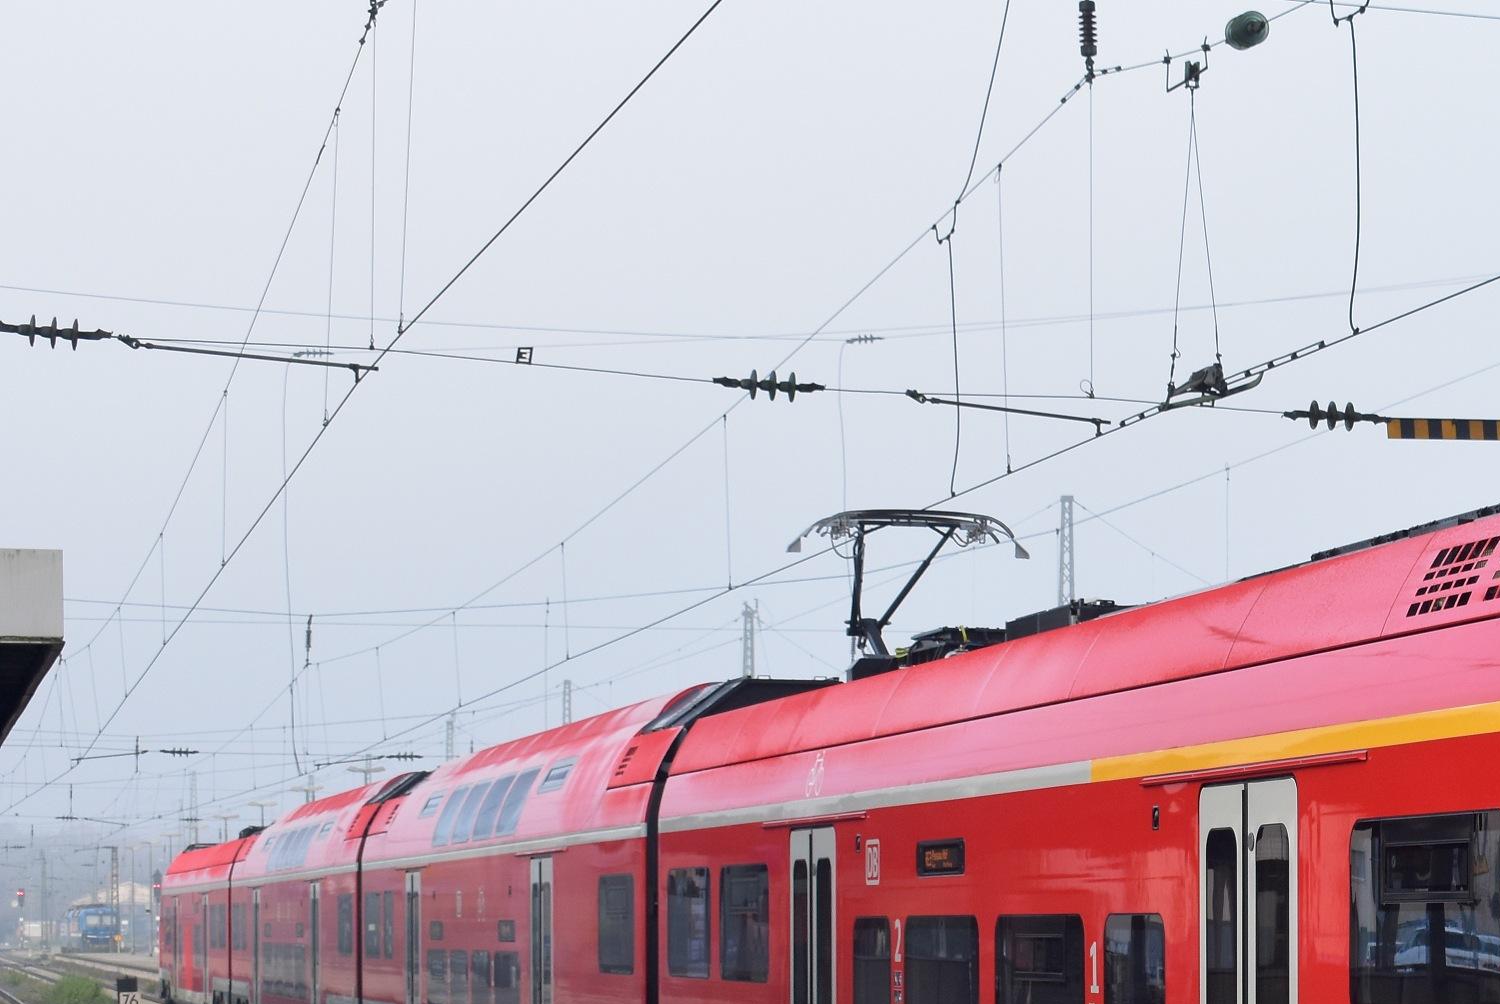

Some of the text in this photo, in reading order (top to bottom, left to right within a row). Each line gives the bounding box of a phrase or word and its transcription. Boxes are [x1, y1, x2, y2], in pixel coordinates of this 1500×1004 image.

[866, 844, 880, 880] DB
[894, 918, 903, 962] 2
[1089, 940, 1099, 994] 1
